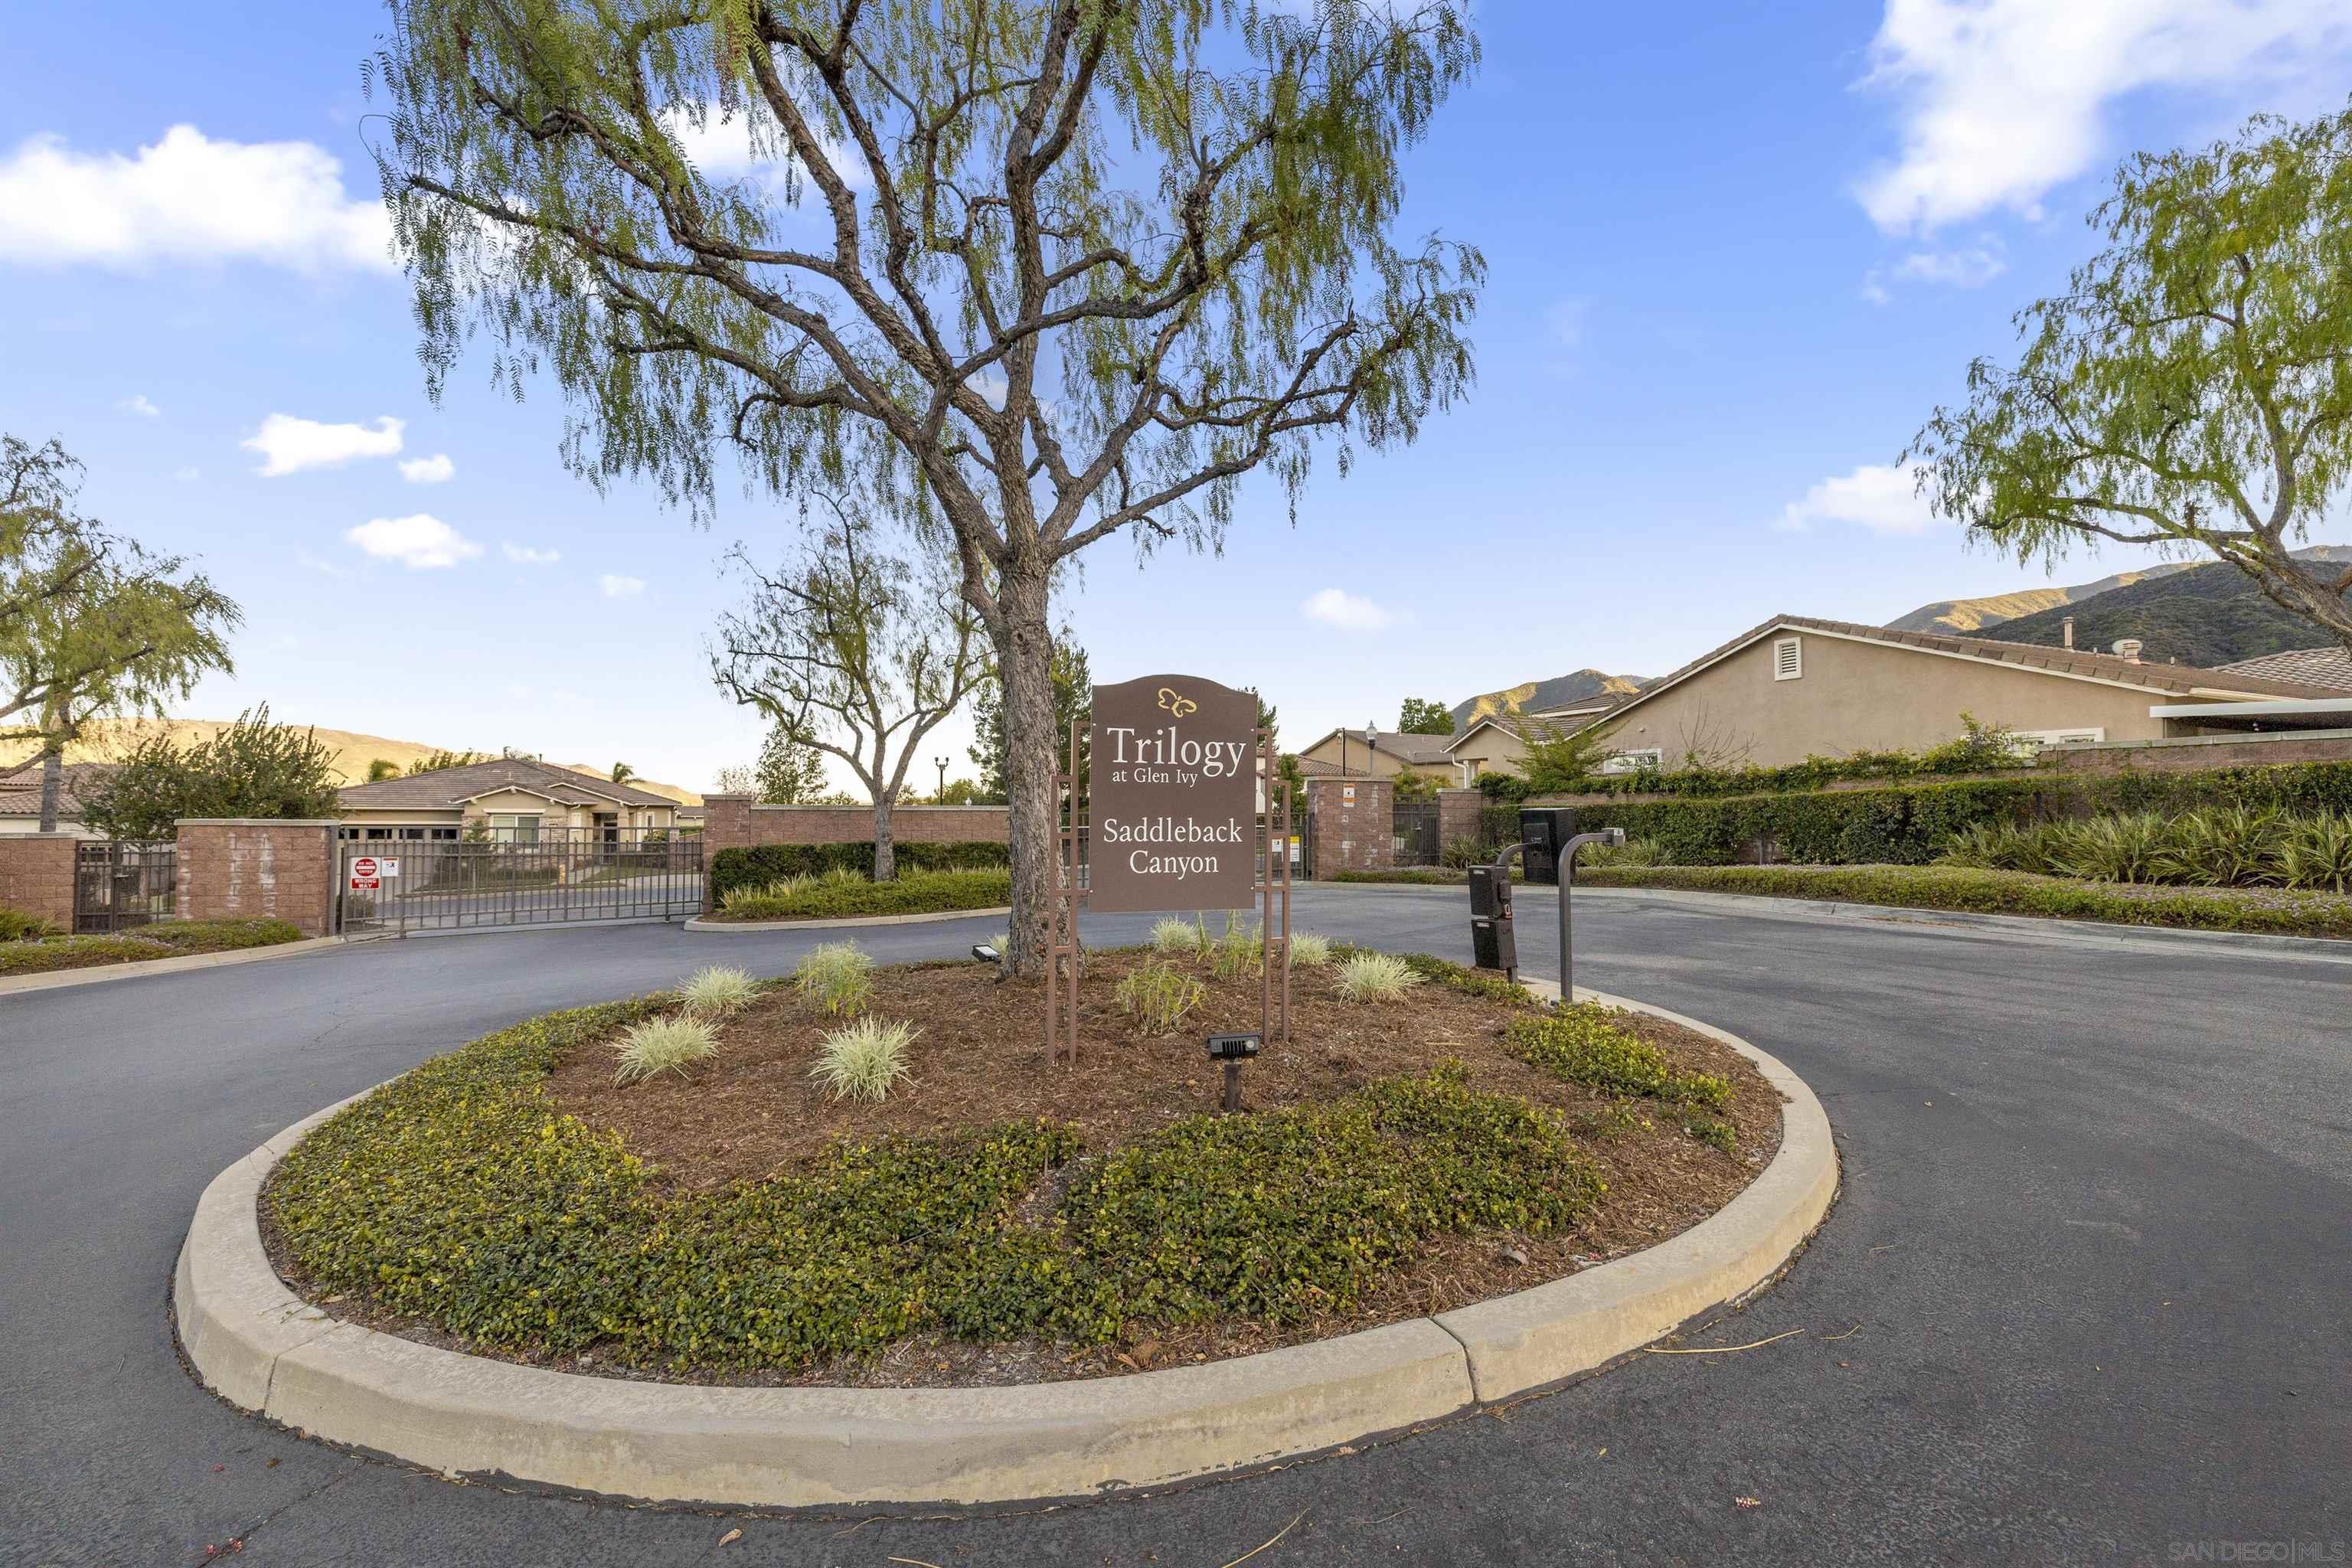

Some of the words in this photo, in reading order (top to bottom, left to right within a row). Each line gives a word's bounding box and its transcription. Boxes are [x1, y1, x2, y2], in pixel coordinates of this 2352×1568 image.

[1106, 726, 1246, 777] Trilogy
[1112, 769, 1128, 782] at
[1134, 767, 1170, 783] Glen
[1176, 769, 1199, 789] Ivy
[1103, 817, 1243, 842] Saddleback
[1129, 850, 1220, 880] Canyon
